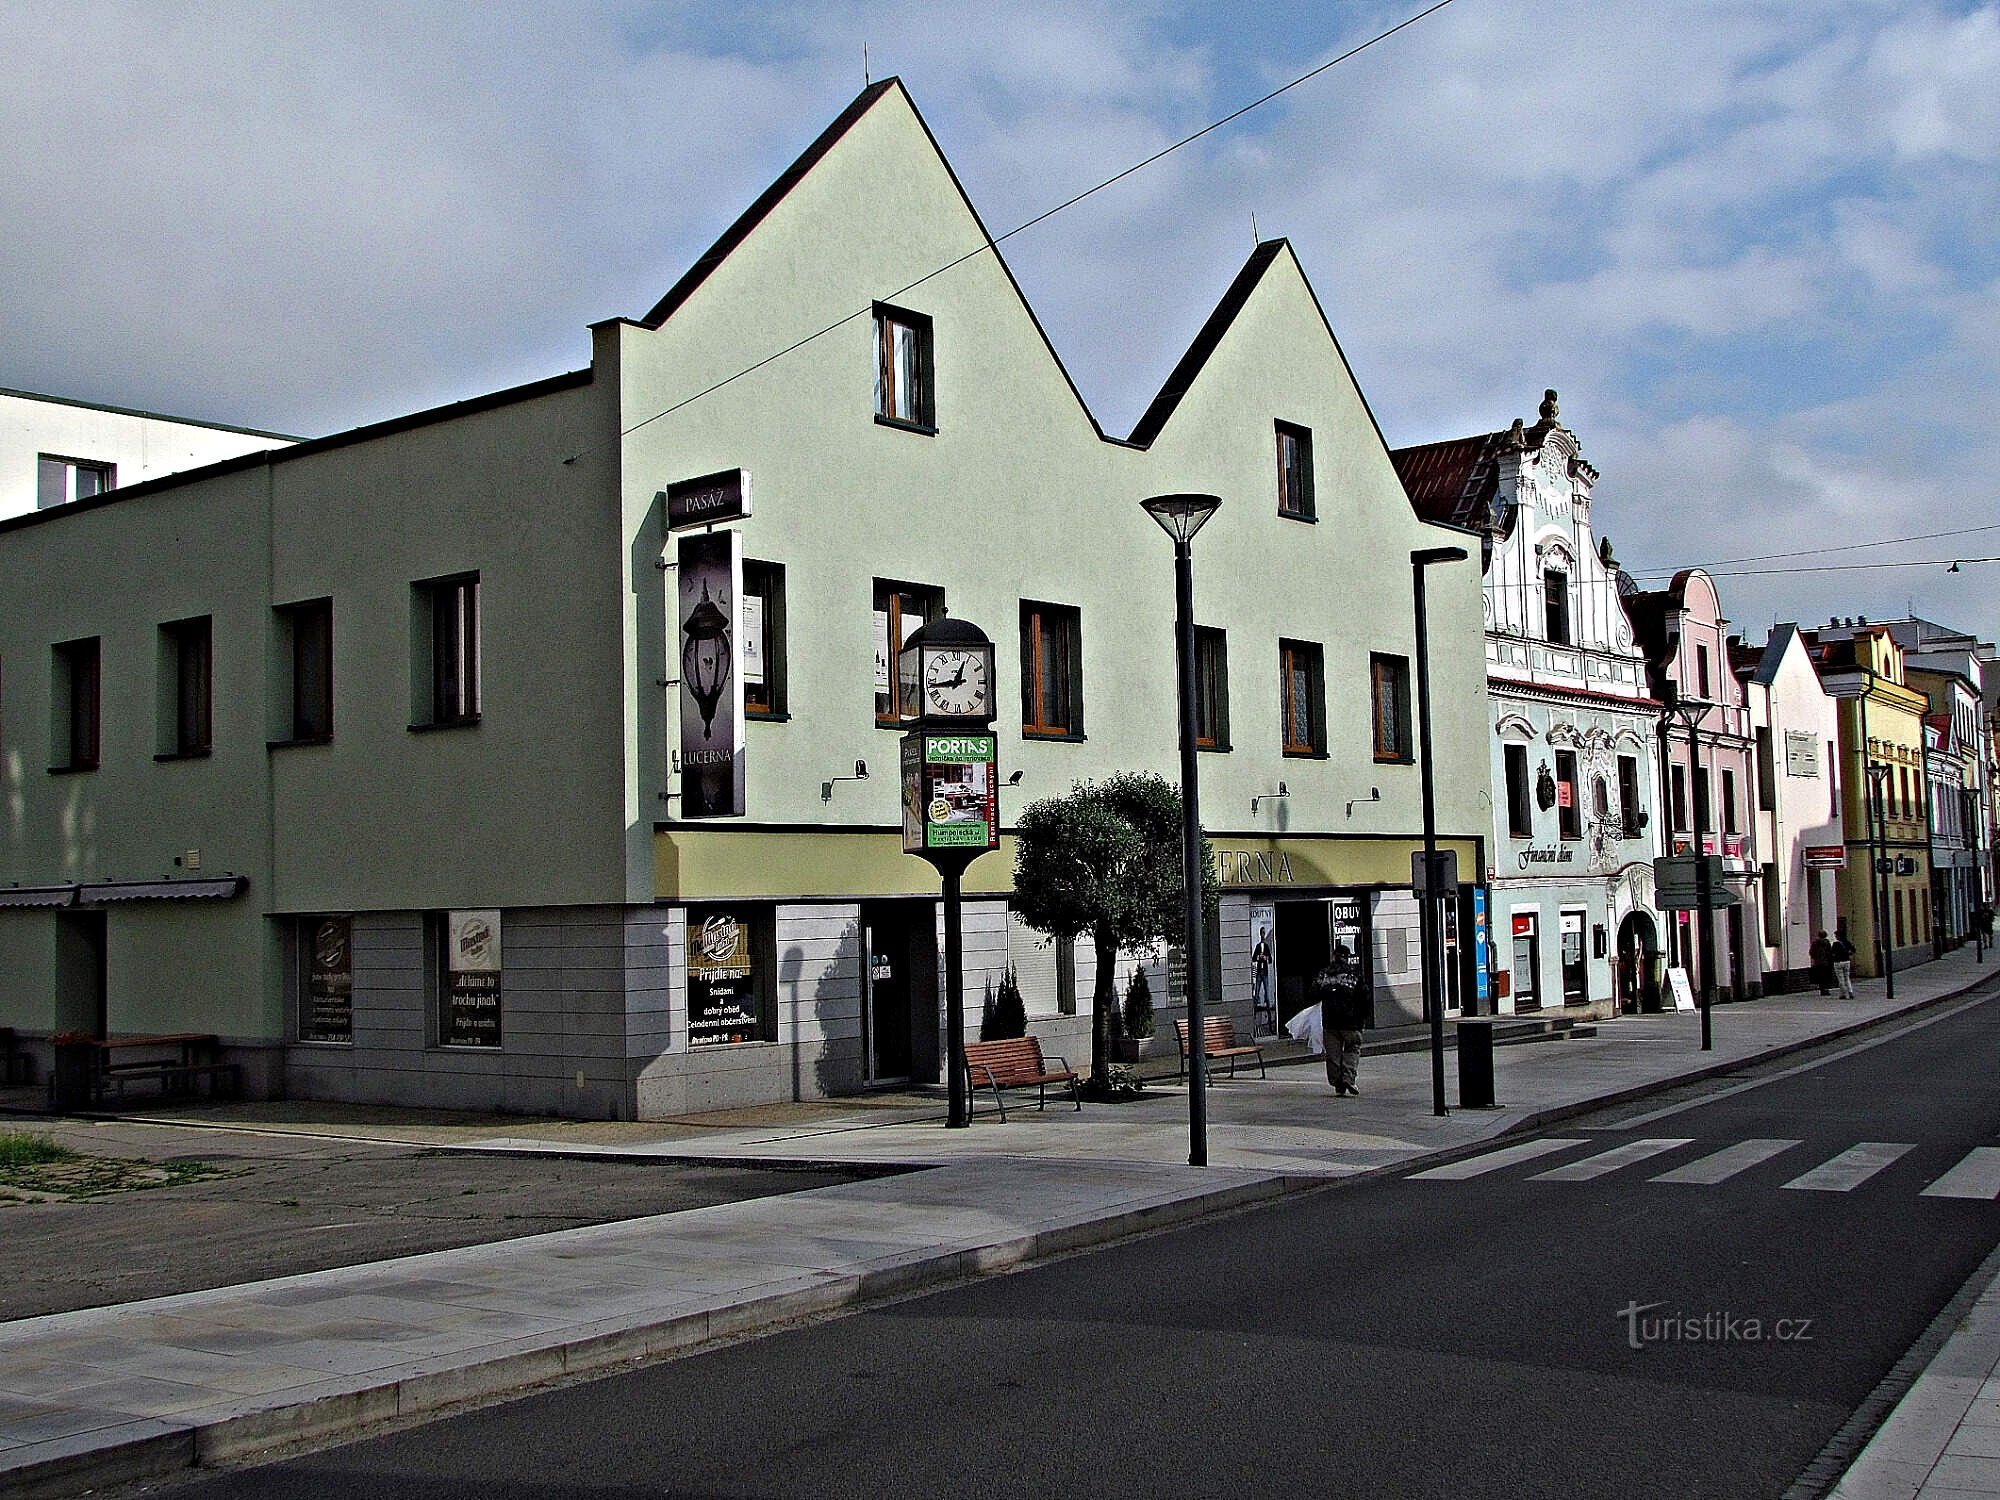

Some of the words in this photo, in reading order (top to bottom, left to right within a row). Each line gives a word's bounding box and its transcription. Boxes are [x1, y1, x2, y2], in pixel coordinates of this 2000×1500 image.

[685, 489, 725, 513] PASÁŽ
[683, 747, 732, 766] LUCERNA
[928, 739, 988, 754] PORTAS
[1218, 850, 1295, 884] ERNA
